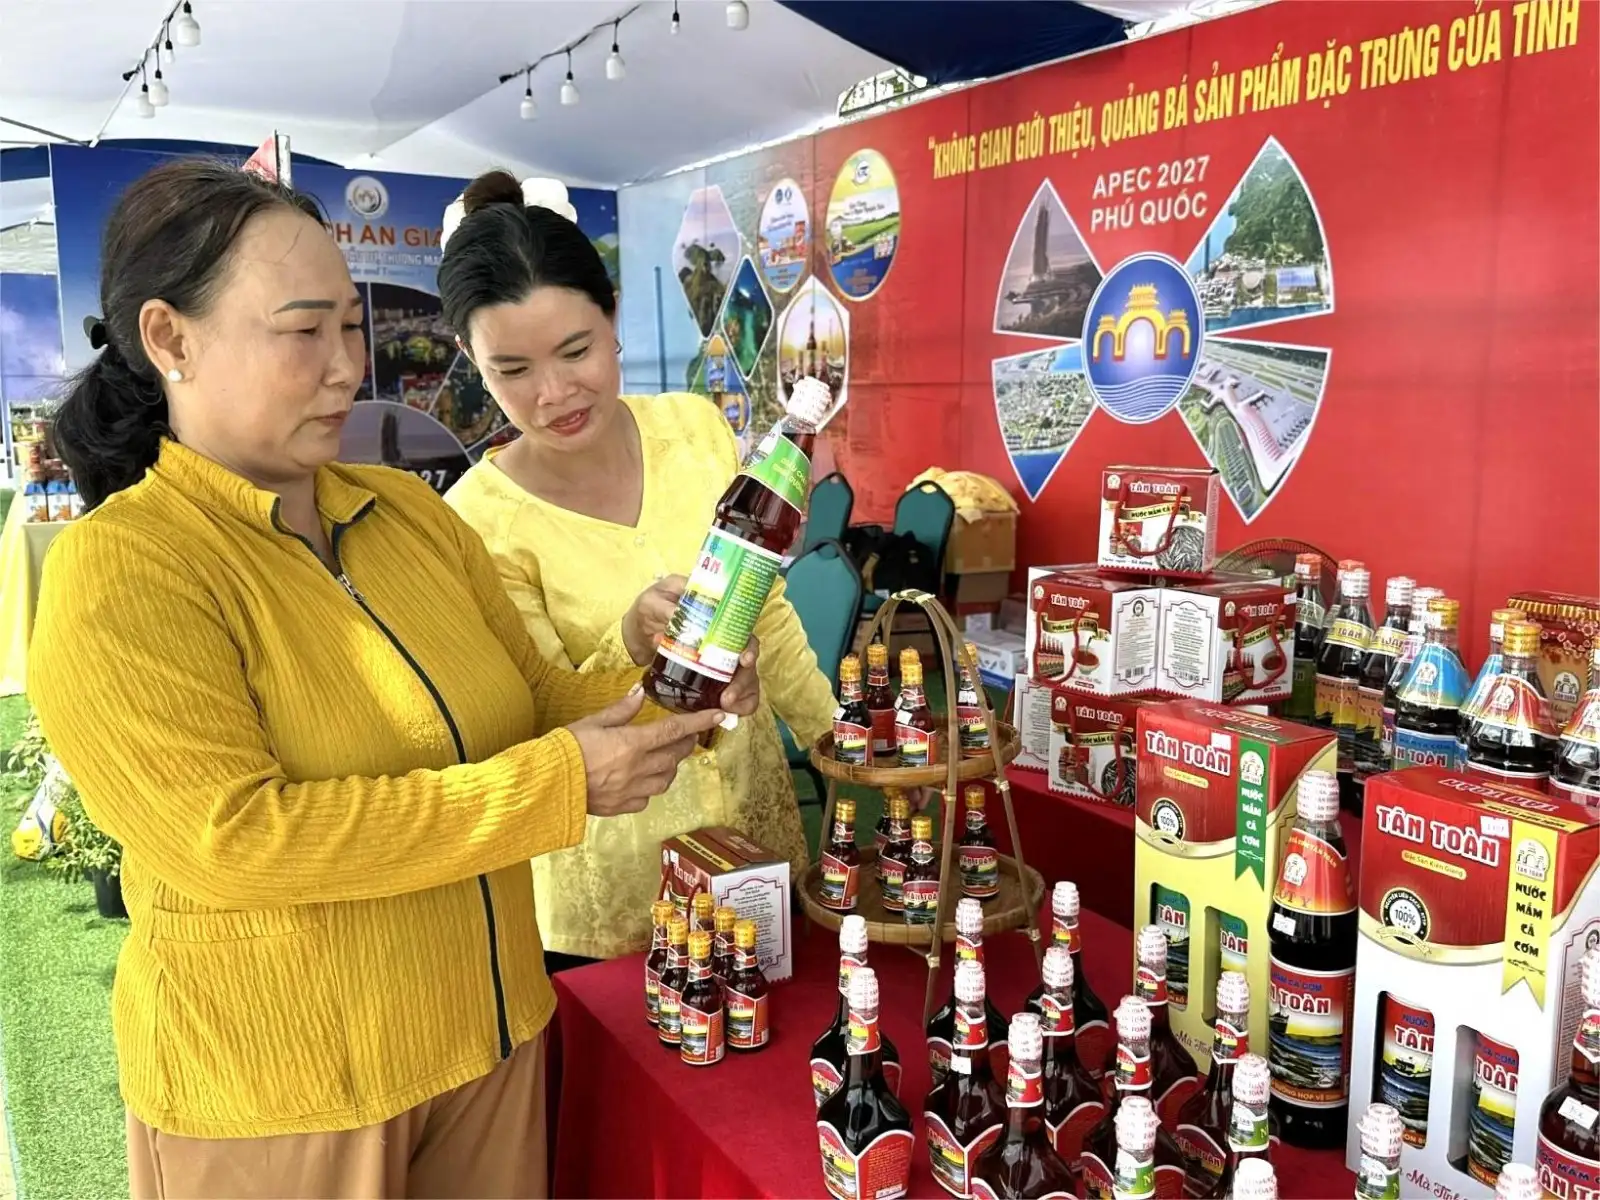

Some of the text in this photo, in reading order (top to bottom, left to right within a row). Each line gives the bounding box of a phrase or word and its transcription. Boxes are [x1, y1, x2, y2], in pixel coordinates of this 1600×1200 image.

[979, 123, 1012, 170] GIAN
[1015, 110, 1045, 161] GIỚI
[1100, 83, 1160, 147] QUẢNG
[1163, 73, 1188, 131] BÁ
[1193, 60, 1235, 124] SẢN
[1238, 42, 1302, 115] PHẨM
[1306, 38, 1352, 109] ĐẶC
[1359, 26, 1441, 90] TRƯNG
[1092, 155, 1210, 200] APEC 2027
[1091, 189, 1208, 233] PHÚ QUỐC
[360, 224, 396, 245] AN
[1145, 730, 1231, 777] TÂN TOÀN
[1408, 748, 1448, 768] TOÀN
[1376, 804, 1500, 868] TÂN TOÀN
[1515, 882, 1547, 902] NƯỚC
[1157, 902, 1186, 928] TÂN
[1394, 909, 1417, 926] 100%
[1515, 902, 1543, 920] MẮM
[1520, 923, 1535, 937] CÁ
[1514, 940, 1540, 958] CƠM
[1279, 987, 1332, 1016] TOÀN
[1394, 1024, 1435, 1055] TÂN
[1406, 1169, 1431, 1191] Mà
